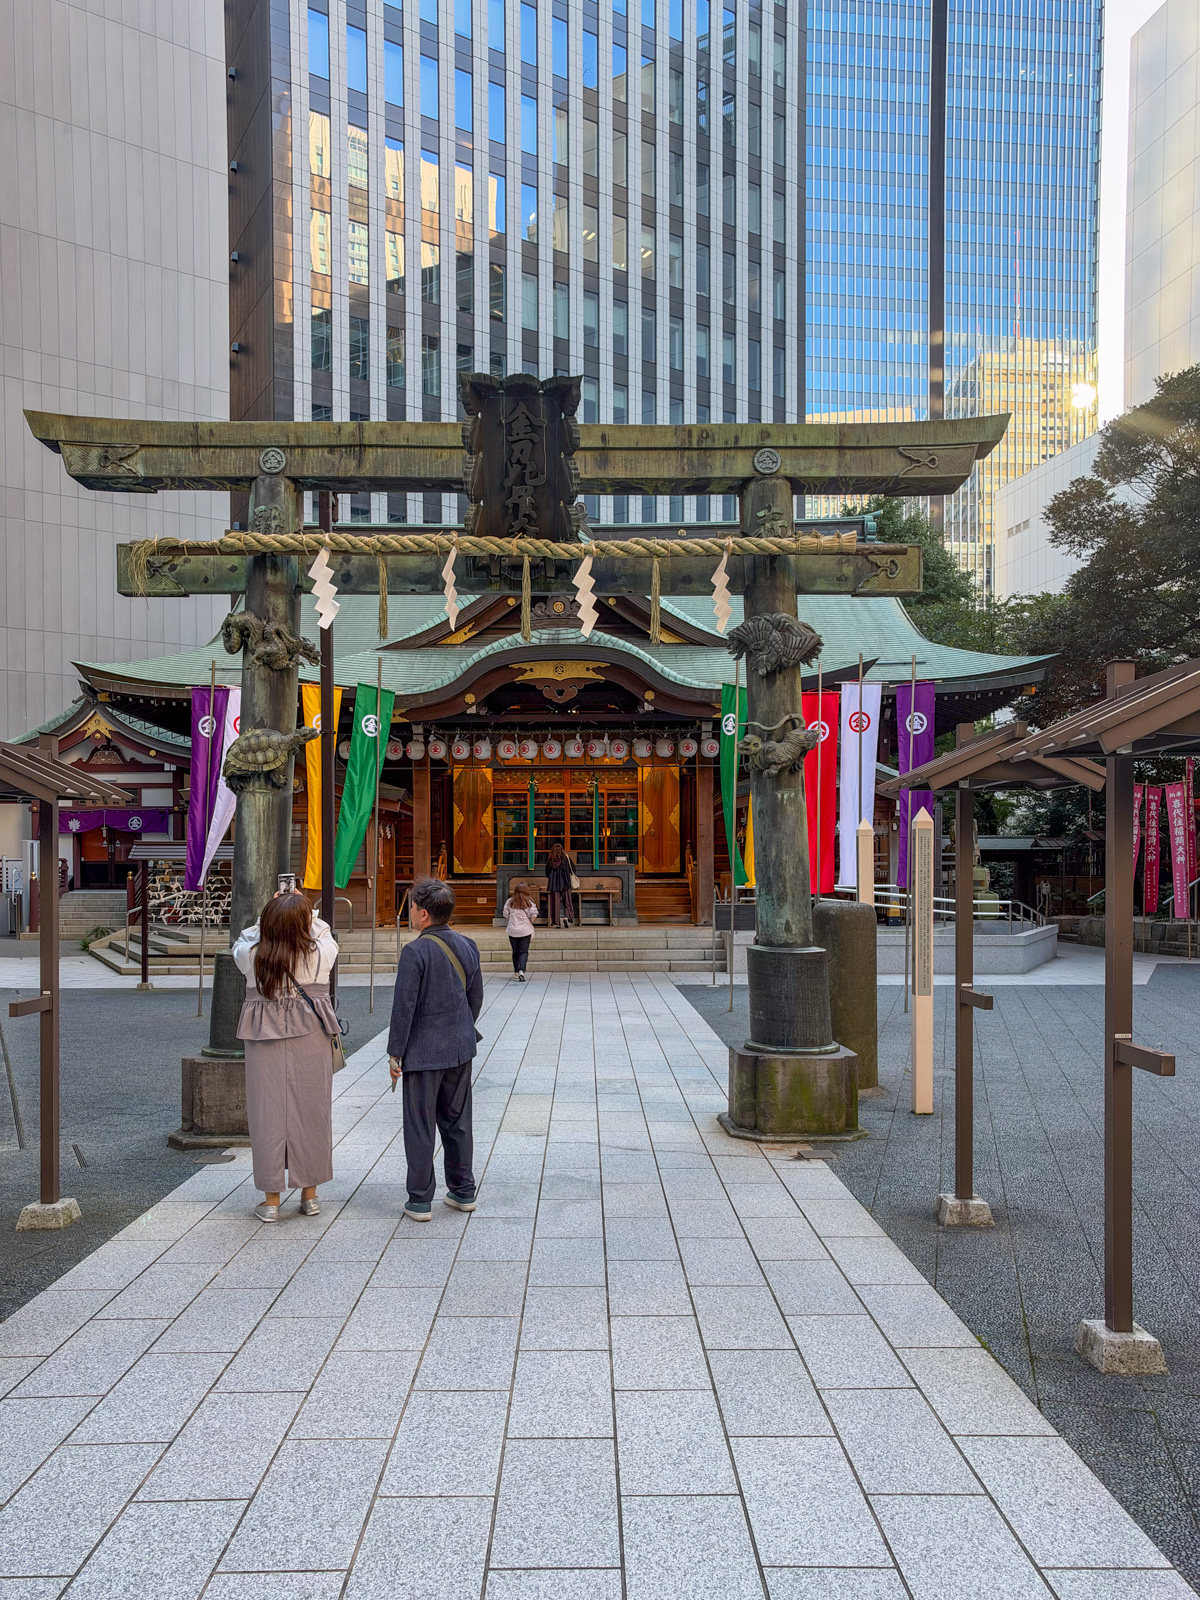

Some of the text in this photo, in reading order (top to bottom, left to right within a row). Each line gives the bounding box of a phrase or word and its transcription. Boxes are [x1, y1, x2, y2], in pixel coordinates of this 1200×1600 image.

[1172, 799, 1186, 864] 喜代住稲荷大神
